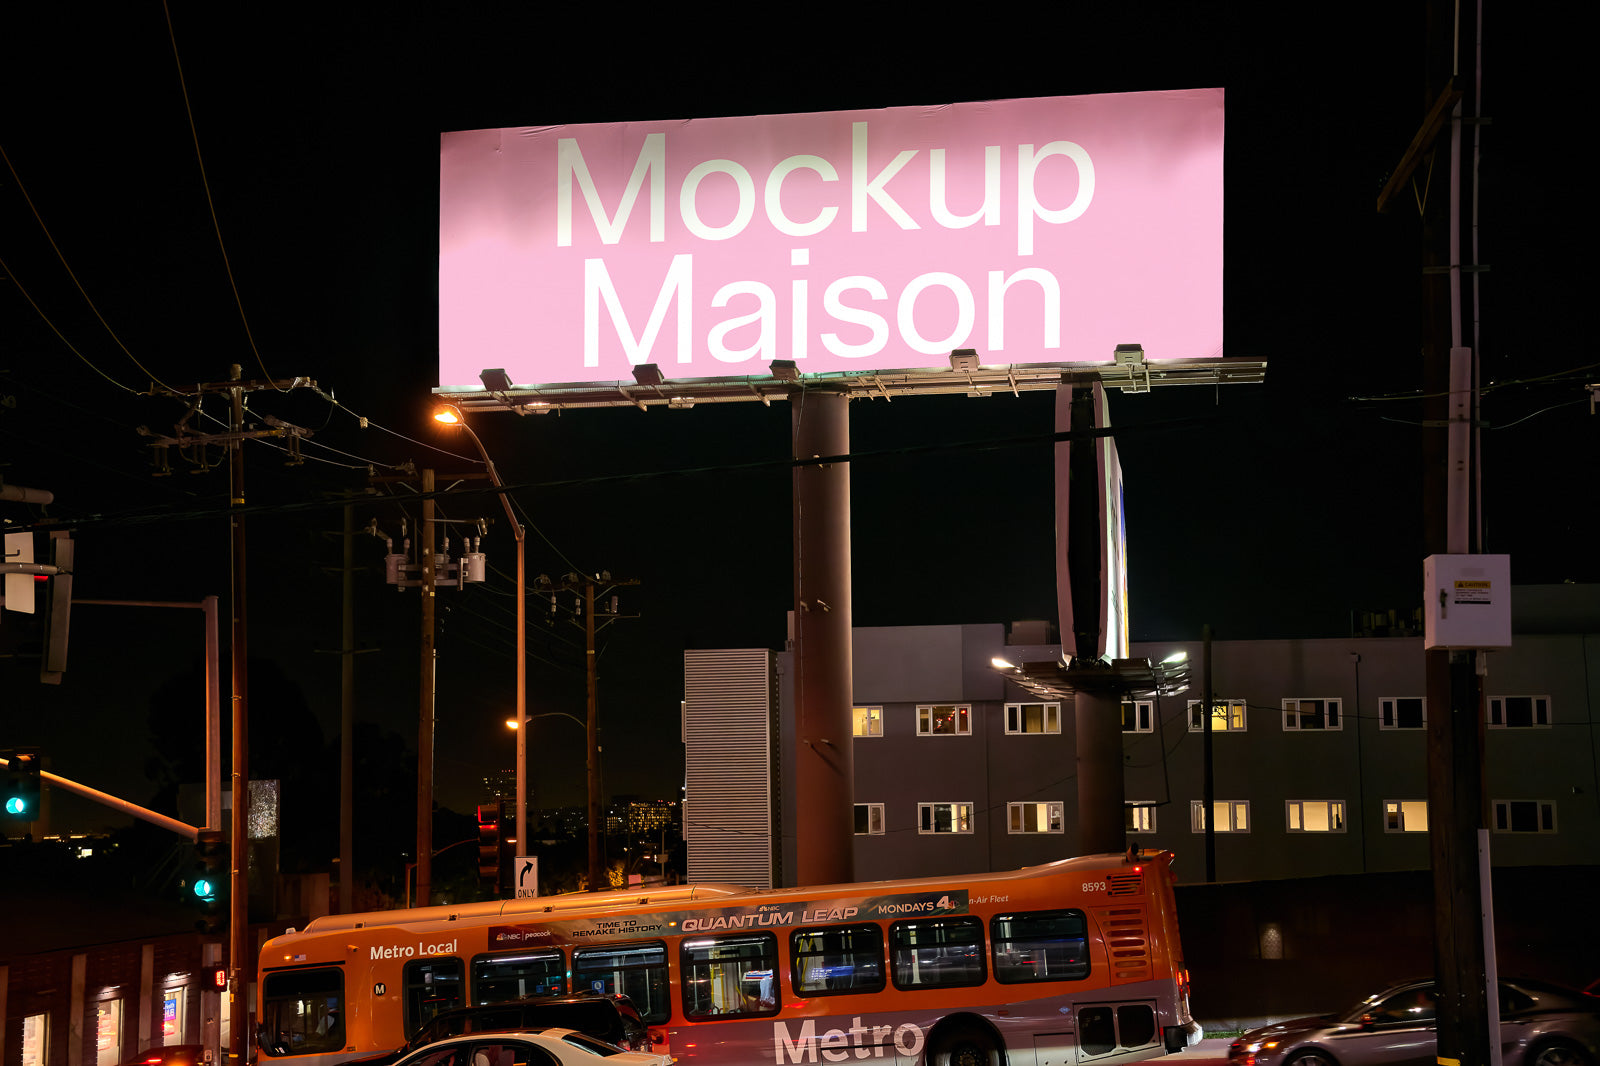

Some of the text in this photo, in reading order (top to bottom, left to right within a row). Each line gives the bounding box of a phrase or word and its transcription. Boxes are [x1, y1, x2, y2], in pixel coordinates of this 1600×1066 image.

[556, 121, 1097, 256] Mockup
[582, 248, 1063, 369] Maison
[1081, 881, 1107, 892] 8593
[517, 889, 535, 899] ONLY
[990, 895, 1009, 903] Fleet
[878, 895, 950, 915] MONDAYS 4
[596, 921, 620, 929] TIME
[681, 906, 859, 932] QUANTUM LEAP
[525, 930, 552, 941] peacock
[572, 924, 663, 937] REMAKE HISTORY
[370, 939, 457, 960] Metro Local
[375, 984, 385, 995] M
[773, 1016, 925, 1065] Metro
